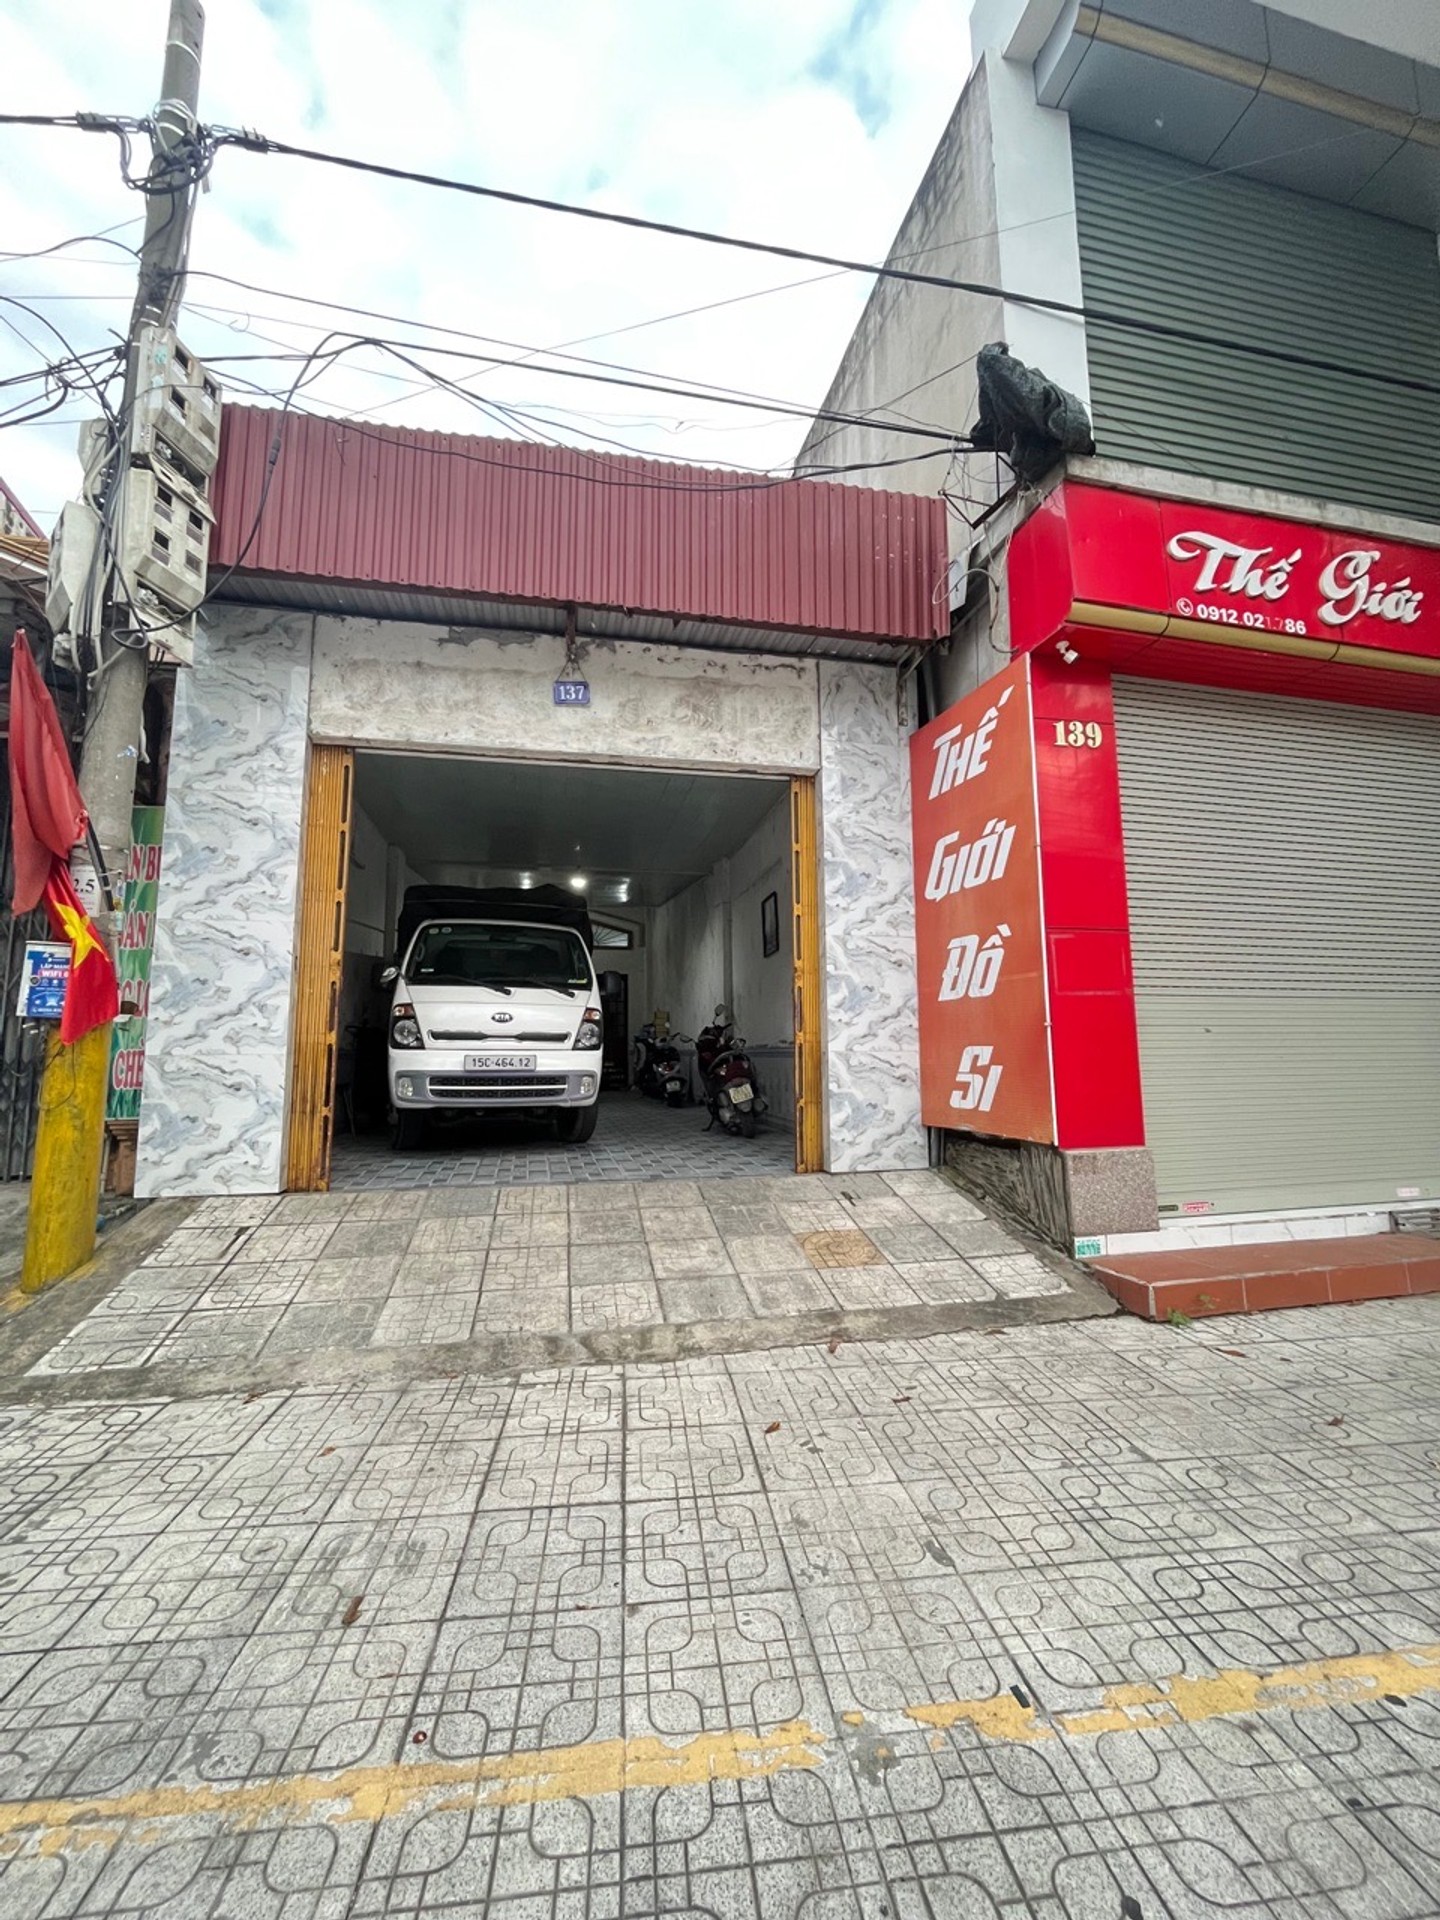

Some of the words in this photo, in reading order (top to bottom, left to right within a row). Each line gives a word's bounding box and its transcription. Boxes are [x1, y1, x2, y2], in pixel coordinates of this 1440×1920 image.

[1166, 530, 1303, 602] Thế
[1317, 550, 1424, 626] Giới
[559, 685, 585, 701] 137
[928, 684, 1015, 802] THẾ
[1052, 719, 1103, 749] 139
[924, 816, 1017, 902] GIỚI
[938, 924, 1014, 1002] ĐỒ
[494, 1013, 511, 1022] KIA
[472, 1057, 531, 1068] 15C-464.12
[949, 1044, 1003, 1113] SI
